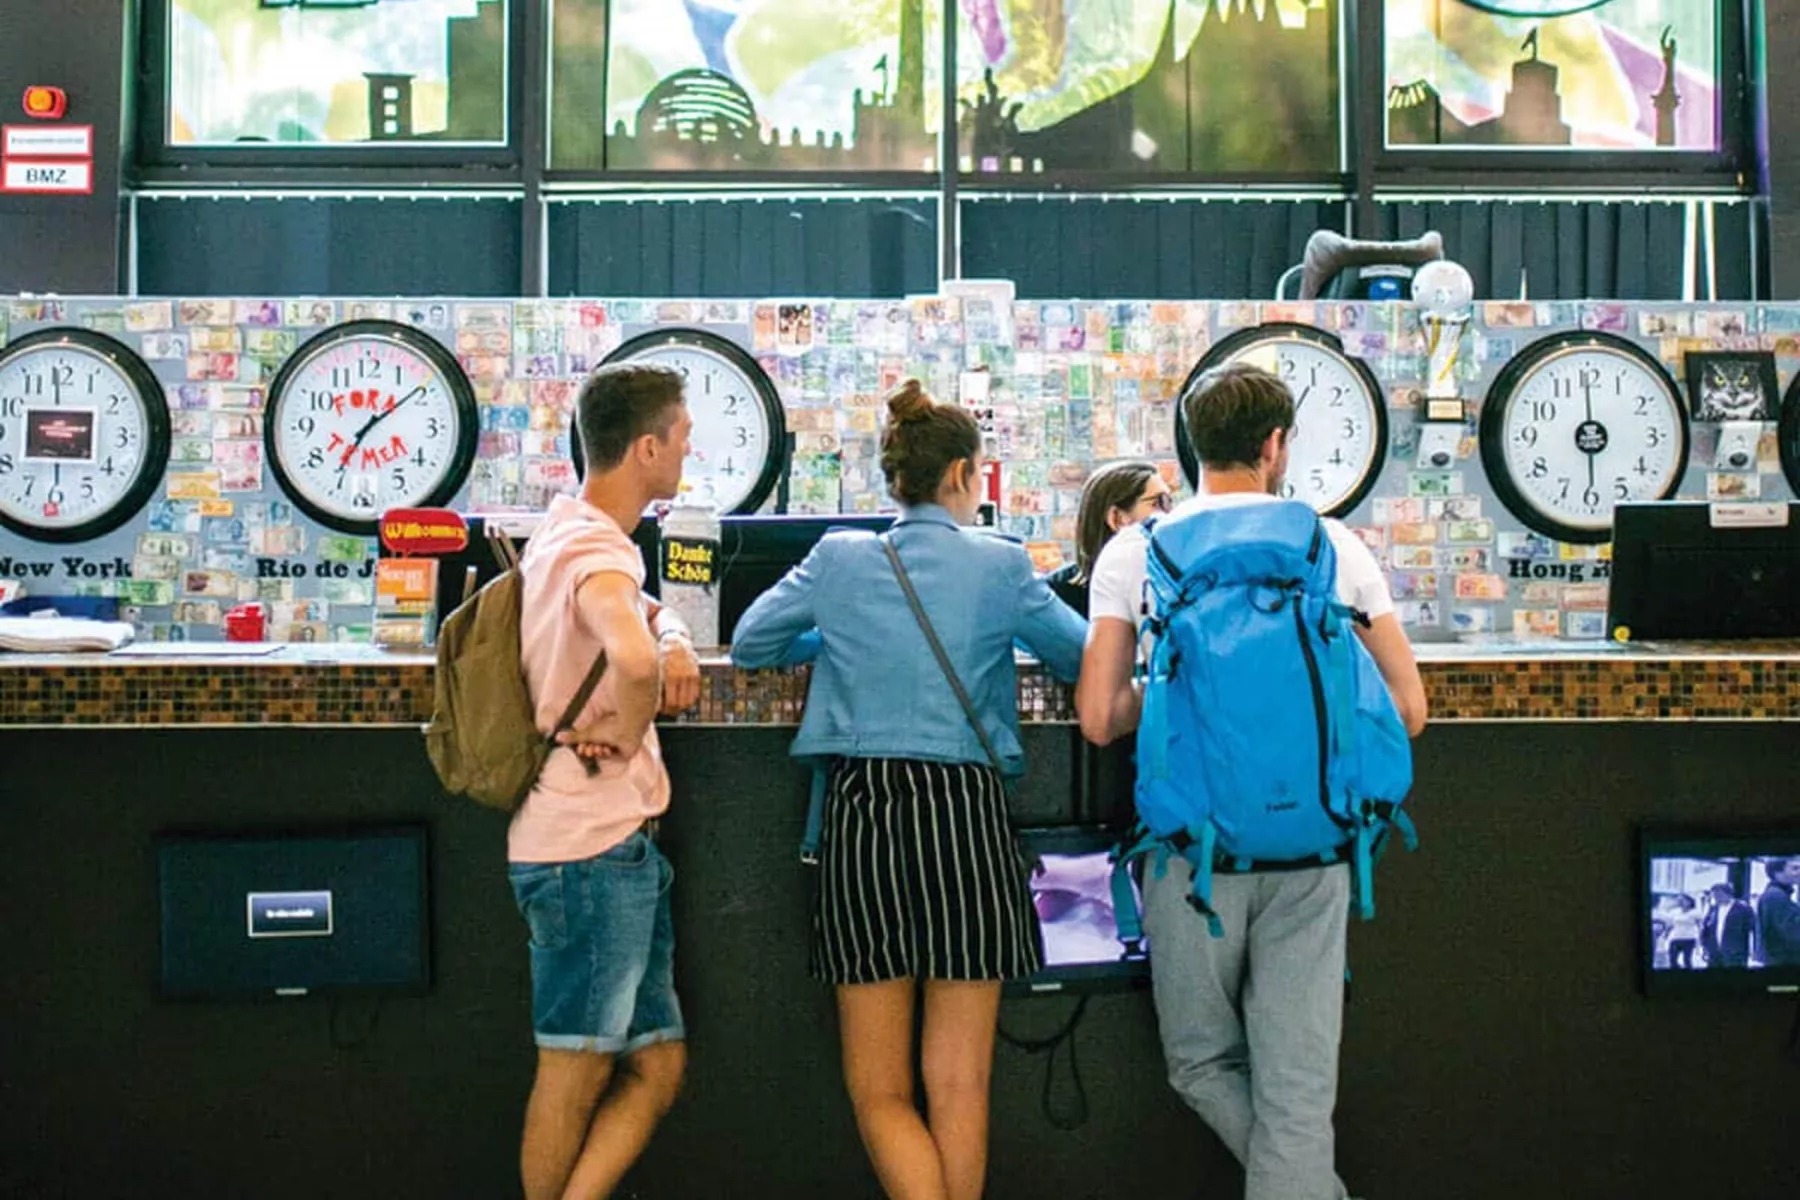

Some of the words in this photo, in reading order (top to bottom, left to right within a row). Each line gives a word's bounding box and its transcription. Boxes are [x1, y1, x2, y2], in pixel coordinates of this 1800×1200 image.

[26, 168, 67, 183] BMZ
[332, 367, 349, 388] 11
[358, 359, 381, 379] 12
[25, 374, 43, 395] 11
[1553, 378, 1571, 398] 11
[105, 395, 119, 415] 2
[310, 391, 333, 412] 10
[334, 389, 396, 416] FORA
[722, 394, 737, 415] 2
[1329, 386, 1344, 407] 2
[1634, 396, 1648, 416] 2
[1532, 401, 1556, 421] 10
[115, 427, 128, 448] 3
[298, 417, 315, 438] 9
[425, 418, 438, 439] 3
[734, 426, 747, 447] 3
[1341, 417, 1354, 438] 3
[1521, 426, 1537, 448] 9
[1647, 428, 1659, 448] 3
[100, 456, 114, 476] 4
[308, 447, 324, 469] 8
[410, 446, 426, 467] 4
[720, 456, 735, 476] 4
[1633, 456, 1648, 476] 4
[1531, 457, 1548, 479] 8
[23, 475, 36, 497] 7
[81, 476, 94, 498] 5
[391, 468, 405, 490] 5
[1310, 468, 1324, 490] 5
[1558, 478, 1571, 499] 7
[1614, 477, 1628, 499] 5
[1583, 485, 1599, 507] 6
[61, 556, 133, 578] York
[256, 558, 307, 578] Rio
[315, 558, 350, 578] de
[1508, 558, 1584, 584] Hong
